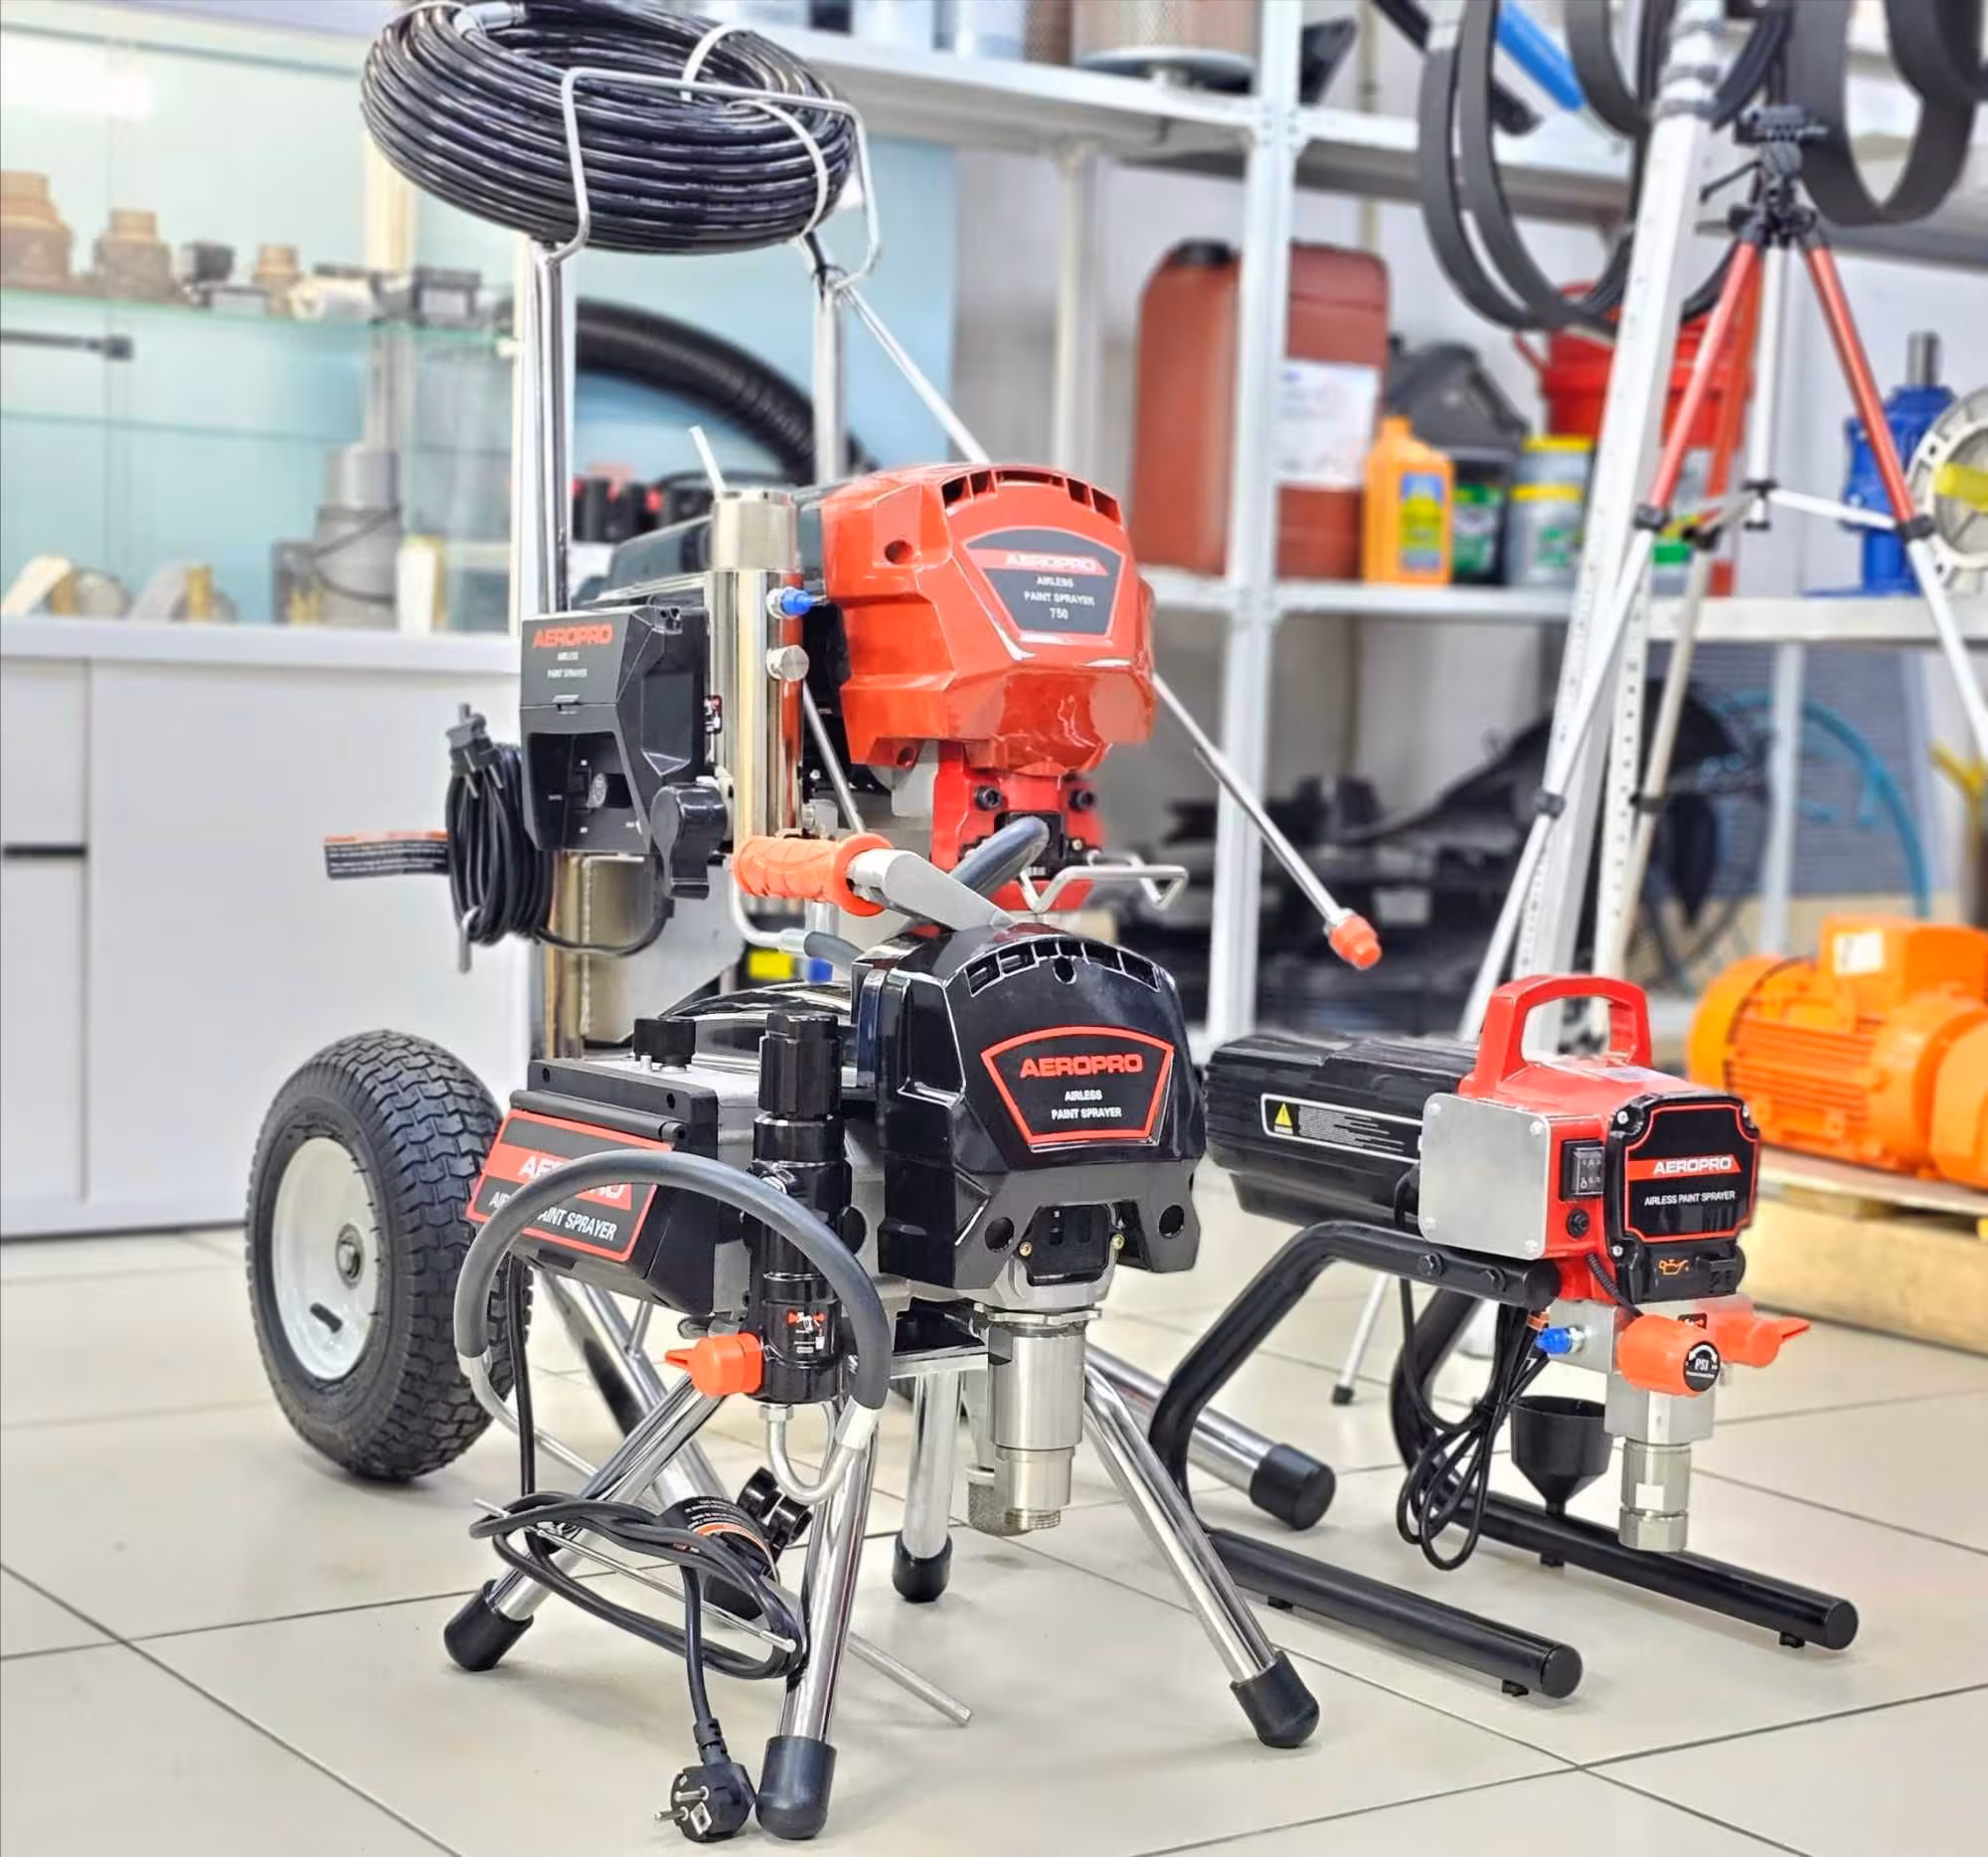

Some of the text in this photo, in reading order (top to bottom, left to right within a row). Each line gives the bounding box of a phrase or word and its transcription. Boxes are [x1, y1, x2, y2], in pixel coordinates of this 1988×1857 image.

[1006, 552, 1098, 571] AEROPRO
[1036, 576, 1075, 588] AIRLESS
[1024, 591, 1095, 605] PAINT SPRAYER
[1050, 607, 1069, 619] 750
[532, 623, 613, 647] AEROPRO
[1020, 1054, 1143, 1079] AEROPRO
[1065, 1090, 1102, 1101] AIRLESS
[1051, 1106, 1122, 1120] PAINT SPRAYER
[1653, 1156, 1733, 1175] AEROPRO
[1644, 1190, 1736, 1207] AIRLESS PAINT SPRAYER
[537, 1207, 617, 1241] AINT SPRAYER
[1694, 1358, 1710, 1371] PSI
